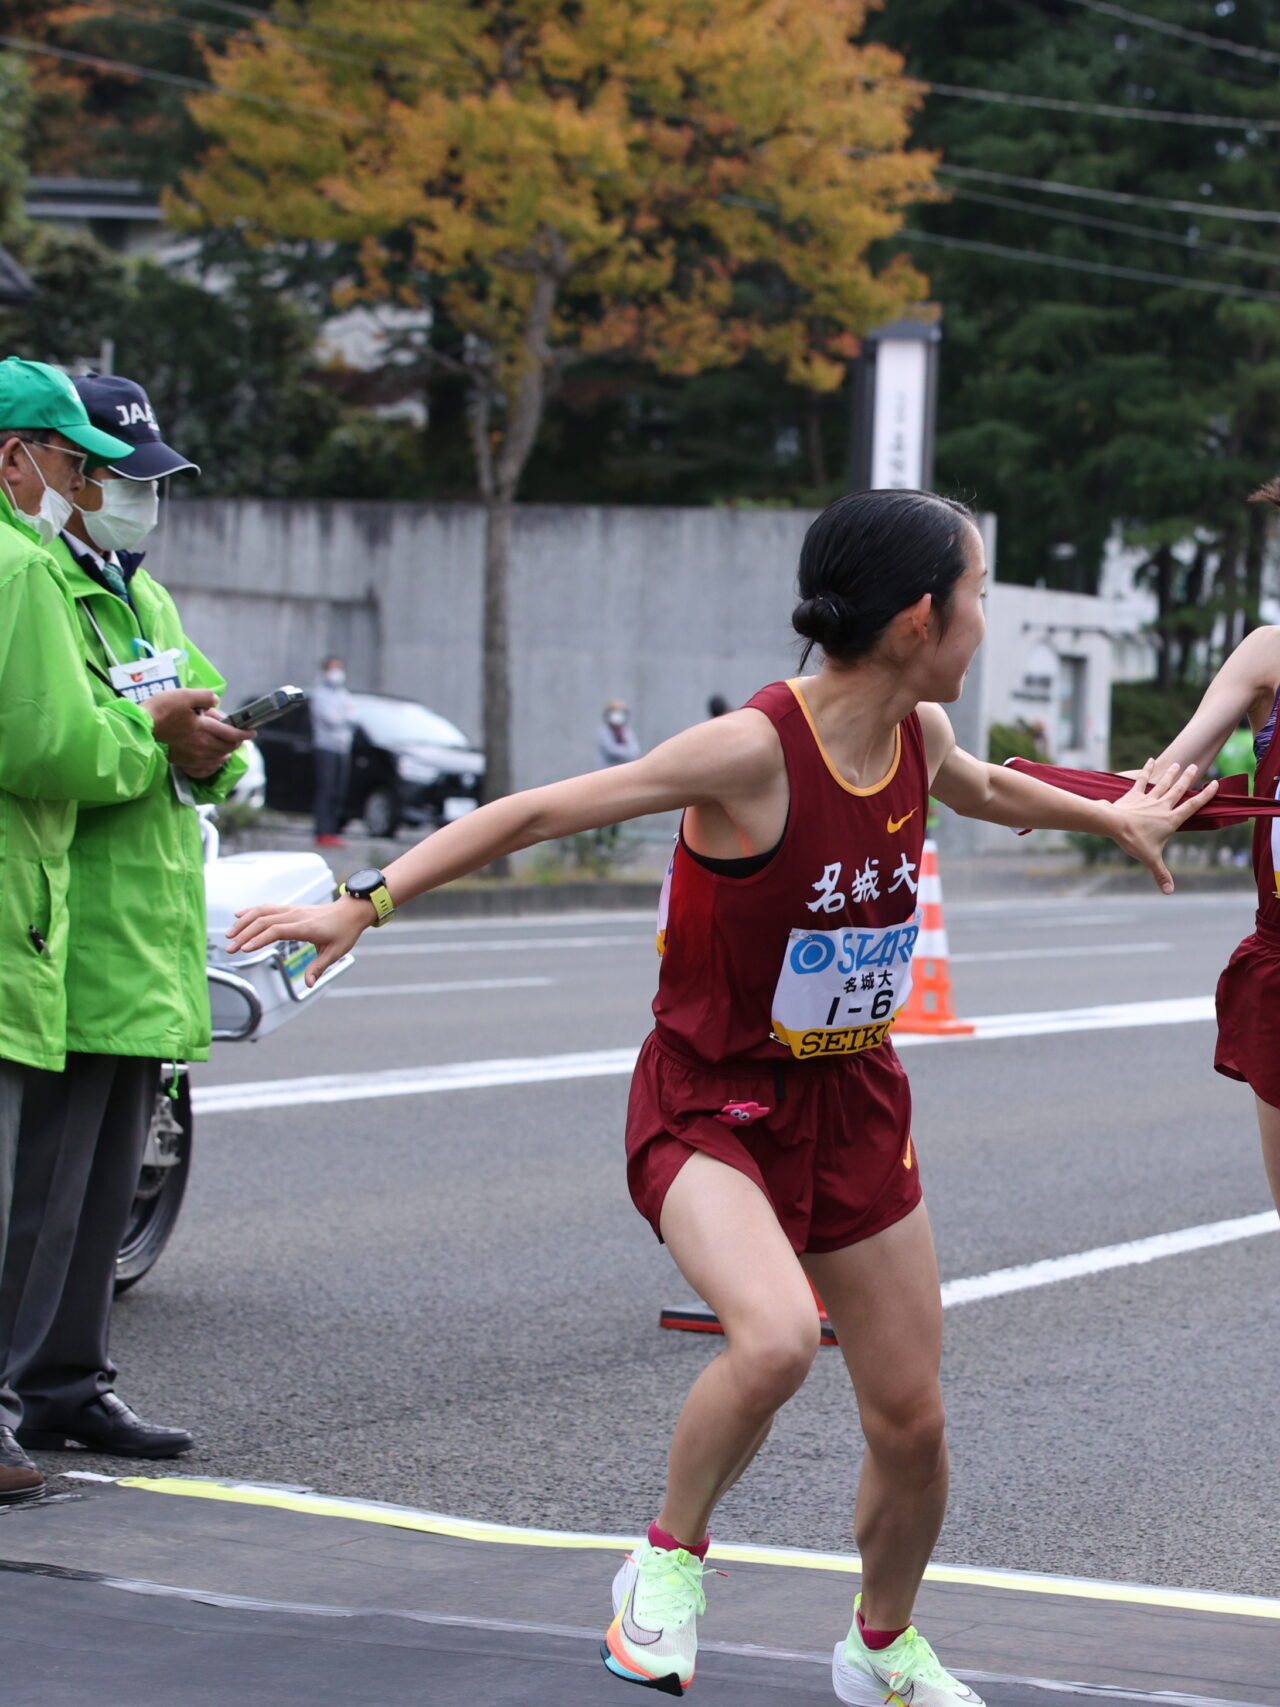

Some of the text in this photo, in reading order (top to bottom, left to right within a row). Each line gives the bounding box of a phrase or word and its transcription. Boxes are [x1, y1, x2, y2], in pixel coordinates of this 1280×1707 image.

[806, 853, 918, 914] 名城大
[843, 969, 893, 994] 名城大
[826, 990, 894, 1026] 1-6
[799, 1022, 891, 1057] SEIK
